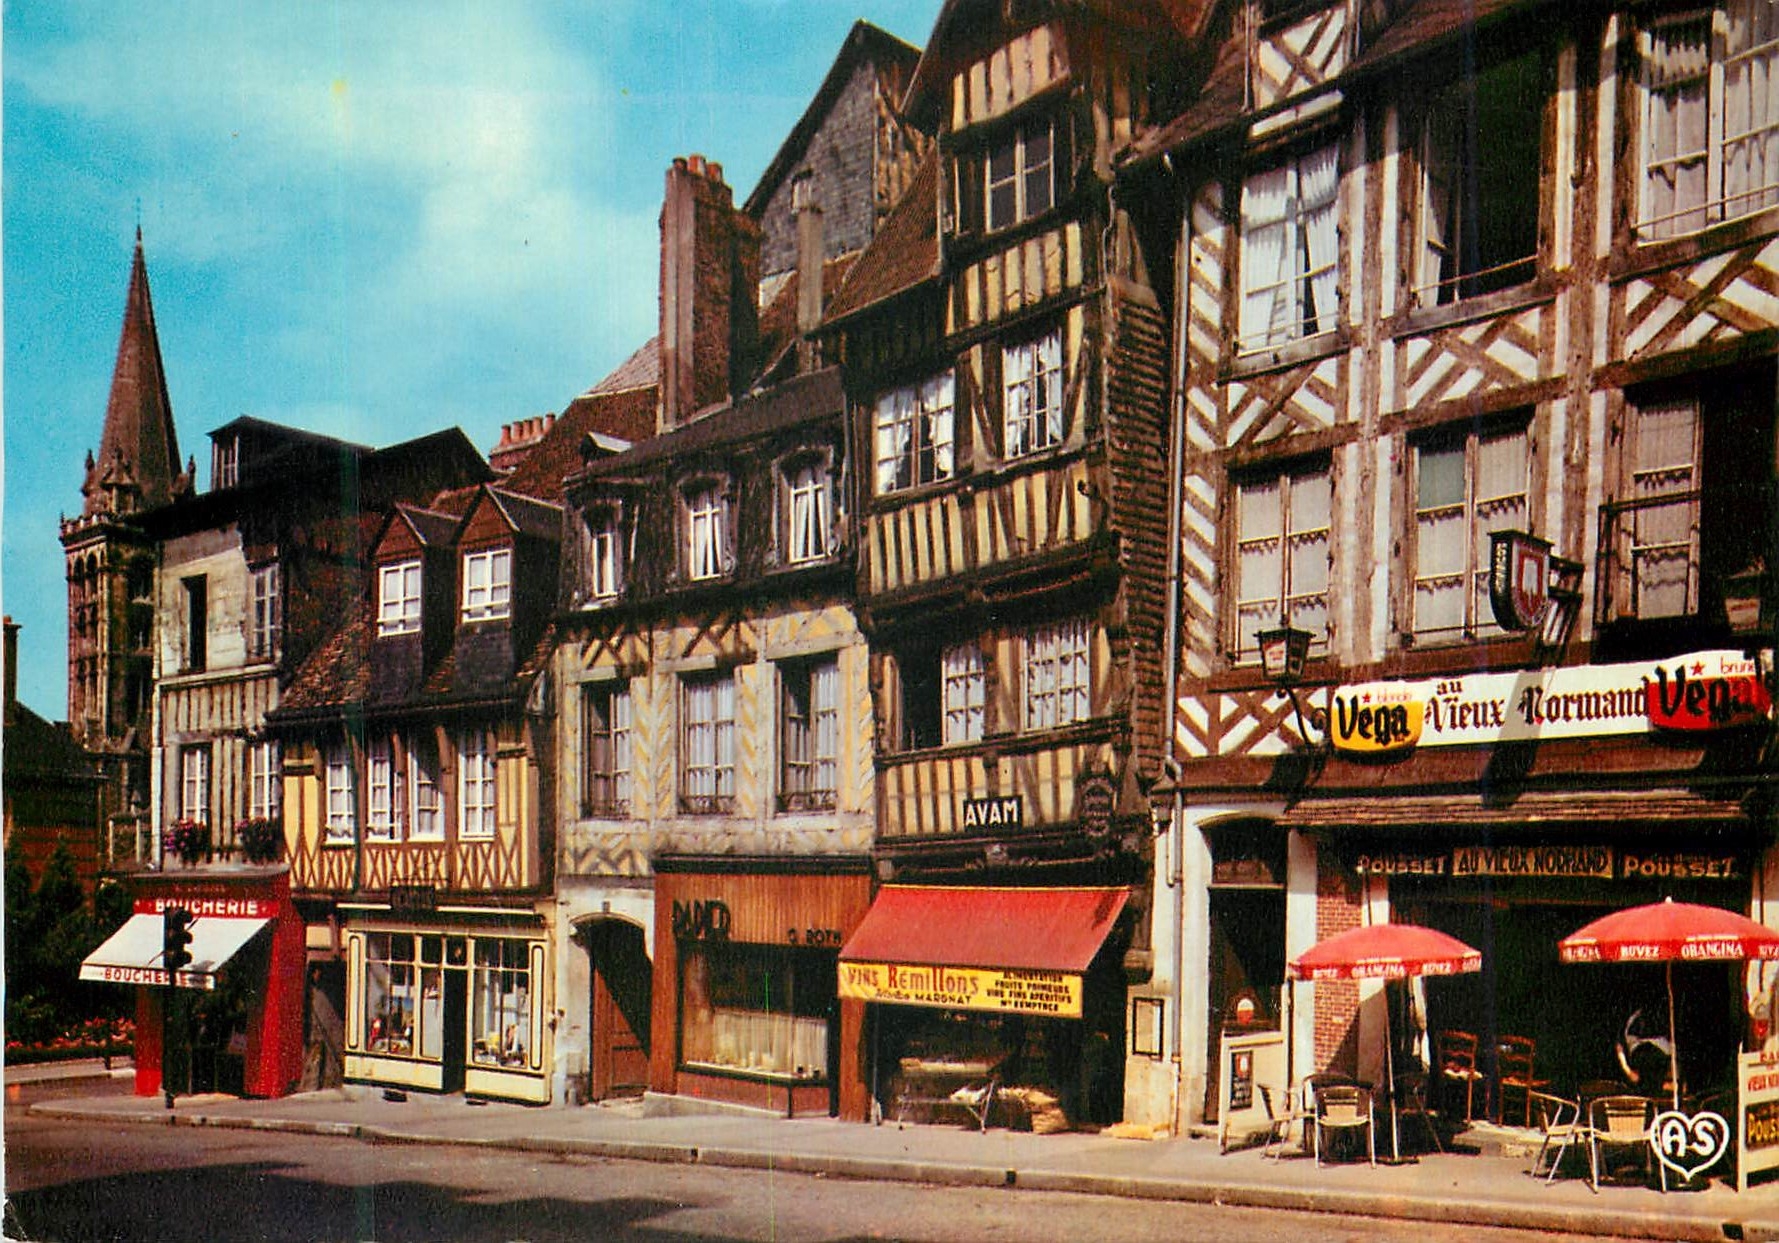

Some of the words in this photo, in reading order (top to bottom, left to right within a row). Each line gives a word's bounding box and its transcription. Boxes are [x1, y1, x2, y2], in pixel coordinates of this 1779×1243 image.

[1437, 680, 1463, 696] au
[1655, 665, 1756, 723] Vega
[1425, 697, 1506, 733] Vieux
[1517, 676, 1652, 725] Normand
[1336, 694, 1411, 746] Vega
[965, 800, 1018, 826] AVAM
[155, 898, 258, 915] BOUCHERIE
[1681, 942, 1745, 958] ORANGINA
